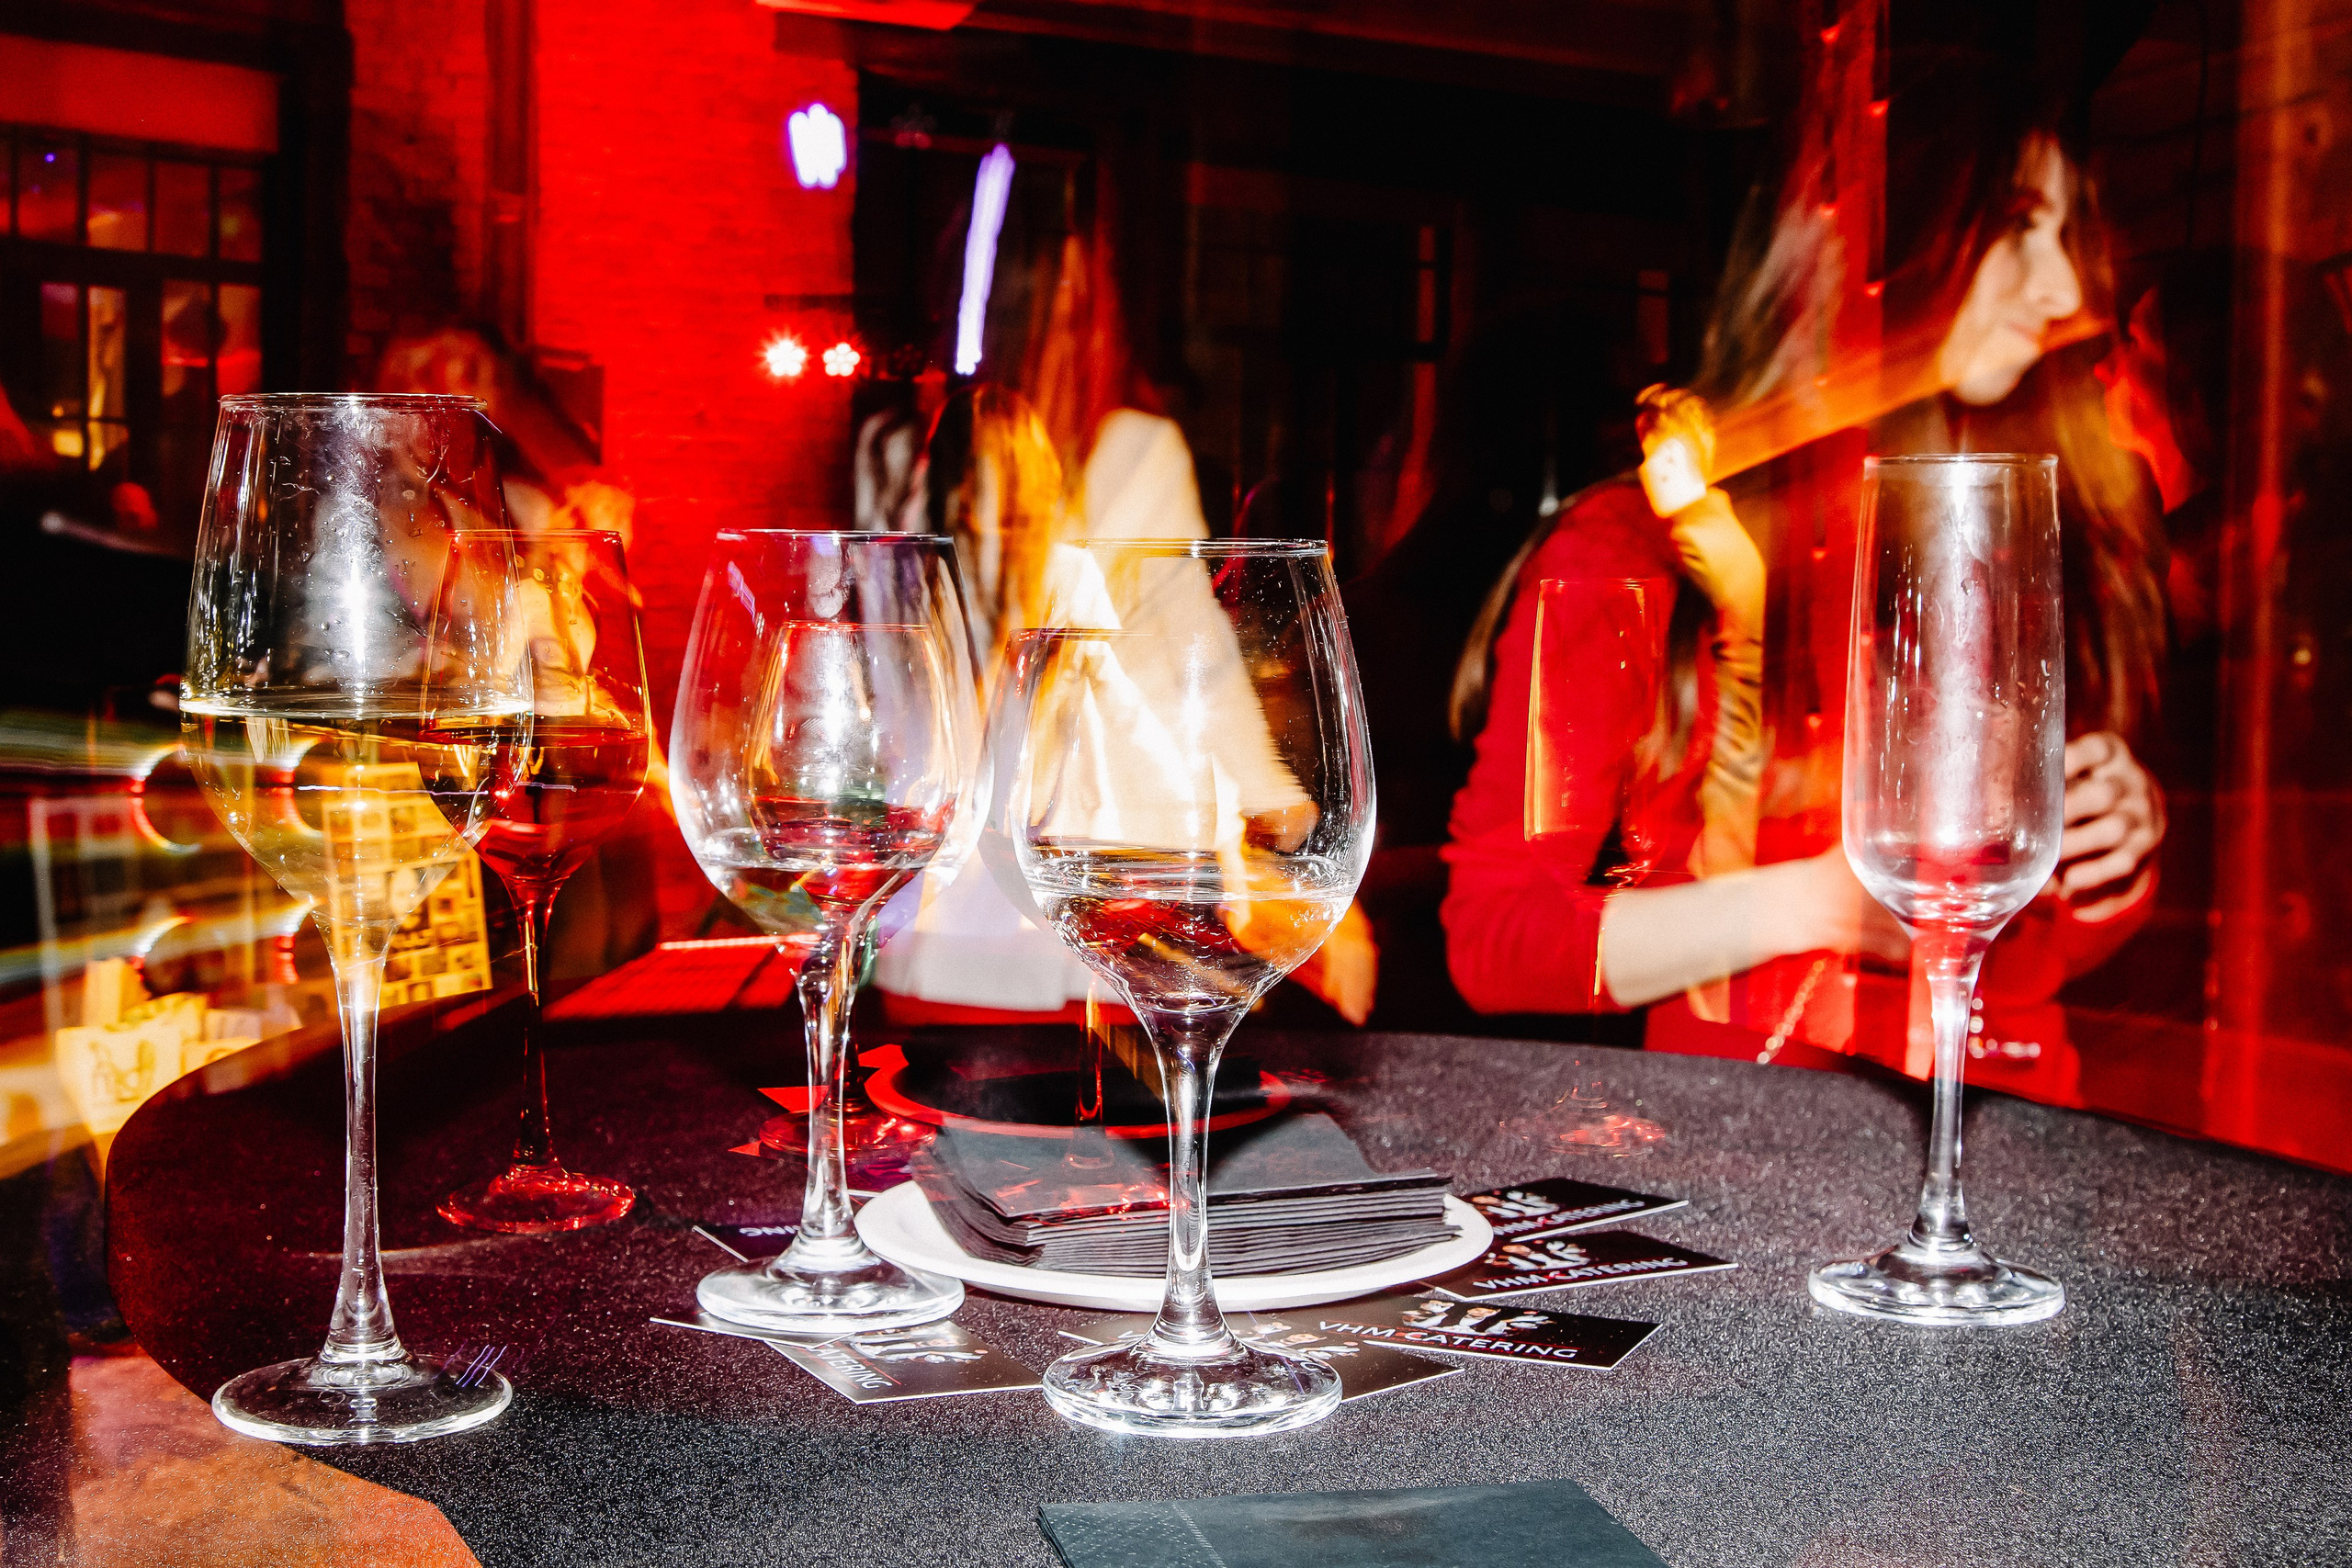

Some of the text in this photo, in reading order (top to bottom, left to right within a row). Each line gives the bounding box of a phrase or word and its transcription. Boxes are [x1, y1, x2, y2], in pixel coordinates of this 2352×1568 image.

[1473, 1257, 1689, 1290] VHM CATERING
[1318, 1321, 1578, 1359] VHM CATERING
